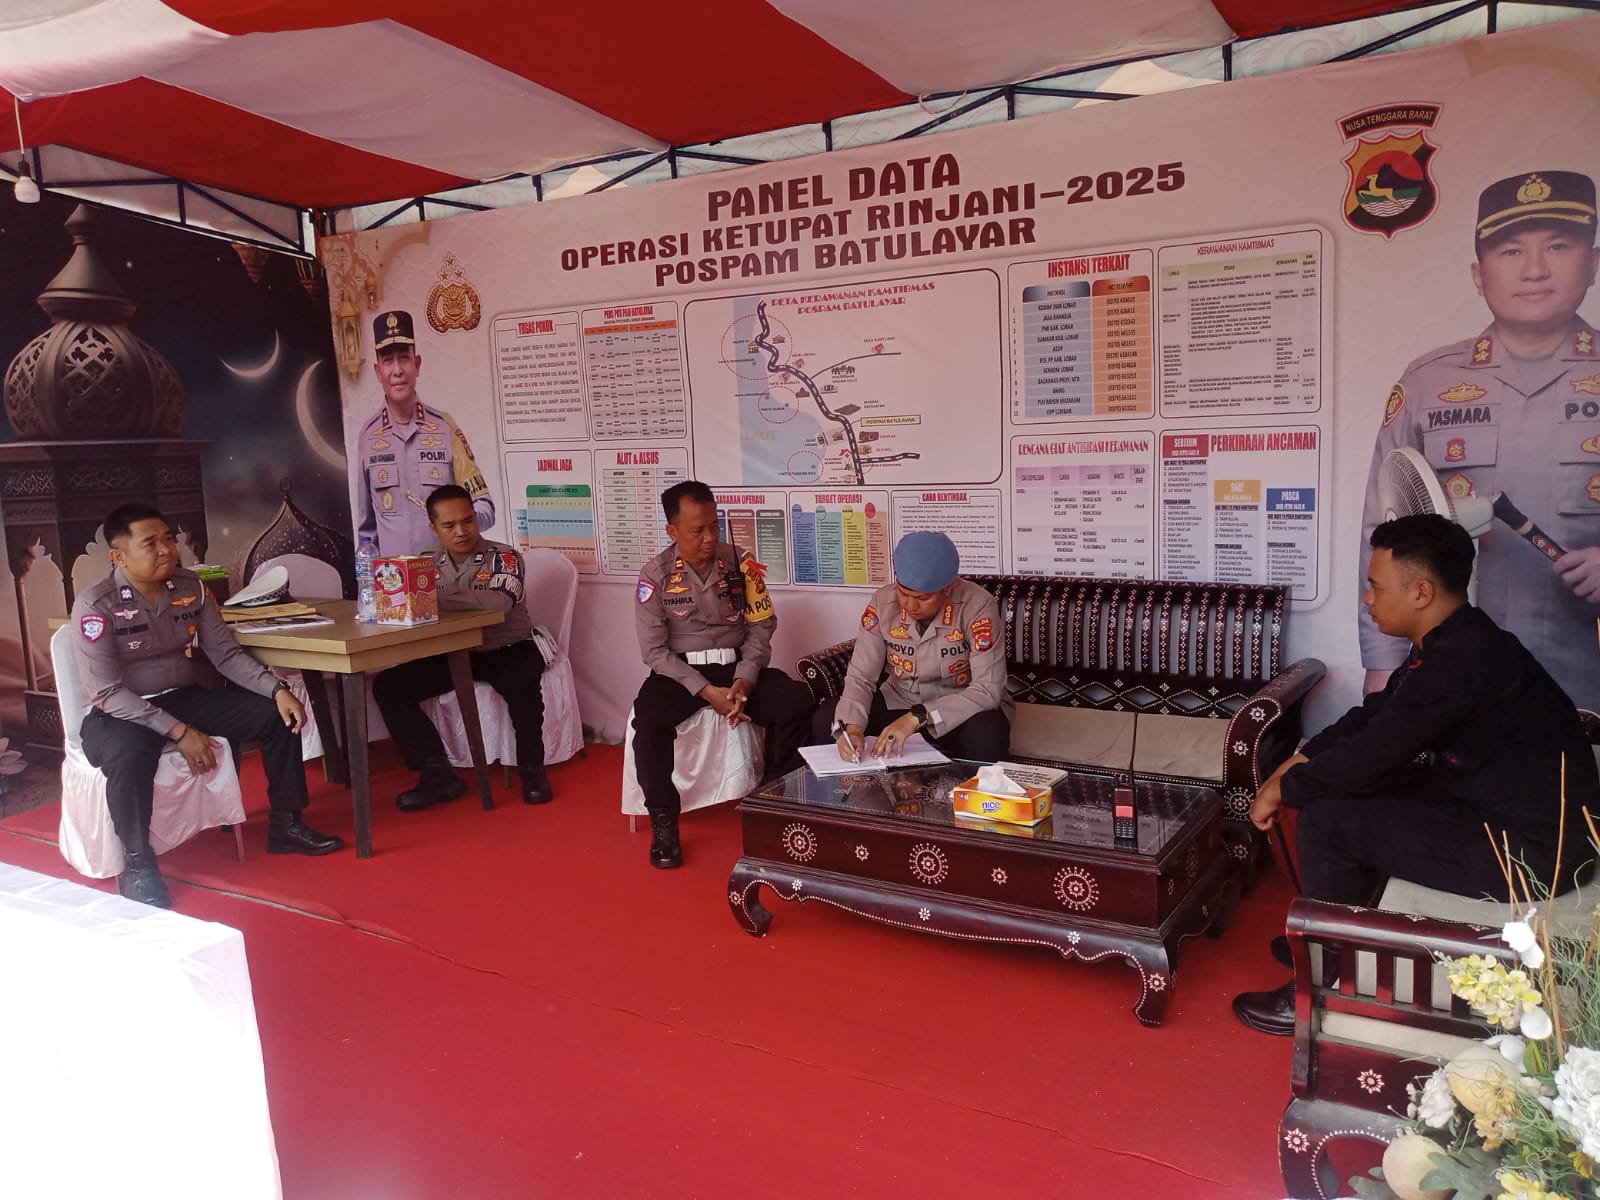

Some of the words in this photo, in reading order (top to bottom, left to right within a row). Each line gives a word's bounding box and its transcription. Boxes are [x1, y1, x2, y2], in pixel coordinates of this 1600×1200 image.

[1345, 118, 1365, 132] NUSA
[1367, 110, 1407, 126] TENGGARA
[1408, 110, 1434, 121] BARAT
[708, 175, 832, 221] PANEL
[849, 152, 960, 201] DATA
[561, 233, 690, 271] OPERASI
[703, 209, 852, 253] KETUPAT
[1197, 242, 1237, 256] KERAWANAN
[1238, 239, 1274, 252] KAMTIBMAS
[655, 249, 800, 287] POSPAM
[814, 217, 1036, 269] BATULAYAR
[1048, 259, 1090, 278] INSTANSI
[1092, 254, 1130, 273] TERKAIT
[771, 297, 799, 307] PETA
[800, 290, 866, 304] KERAWANAN
[868, 282, 935, 297] KAMTIBMAS
[798, 304, 841, 315] POSPAM
[843, 297, 906, 310] BATULAYAR
[518, 321, 534, 336] TUGAS
[1428, 407, 1491, 428] YASMARA
[1018, 443, 1049, 456] RENCANA
[1105, 440, 1148, 453] KERAWANAN
[1174, 438, 1198, 448] SEBELUM
[1211, 434, 1264, 452] PERKIRAAN
[1266, 432, 1316, 450] ANCAMAN
[420, 452, 446, 461] POLRI
[616, 452, 632, 464] ALUT
[639, 452, 659, 464] ALSUS
[537, 460, 558, 472] JADWAL
[560, 459, 572, 471] JAGA
[716, 495, 741, 504] SASARAN
[742, 494, 766, 504] OPERASI
[815, 494, 837, 504] TARGET
[838, 494, 862, 504] OPERASI
[922, 494, 936, 502] CARA
[1282, 491, 1300, 500] PASCA
[971, 618, 991, 629] POLDA
[982, 800, 1001, 810] nice
